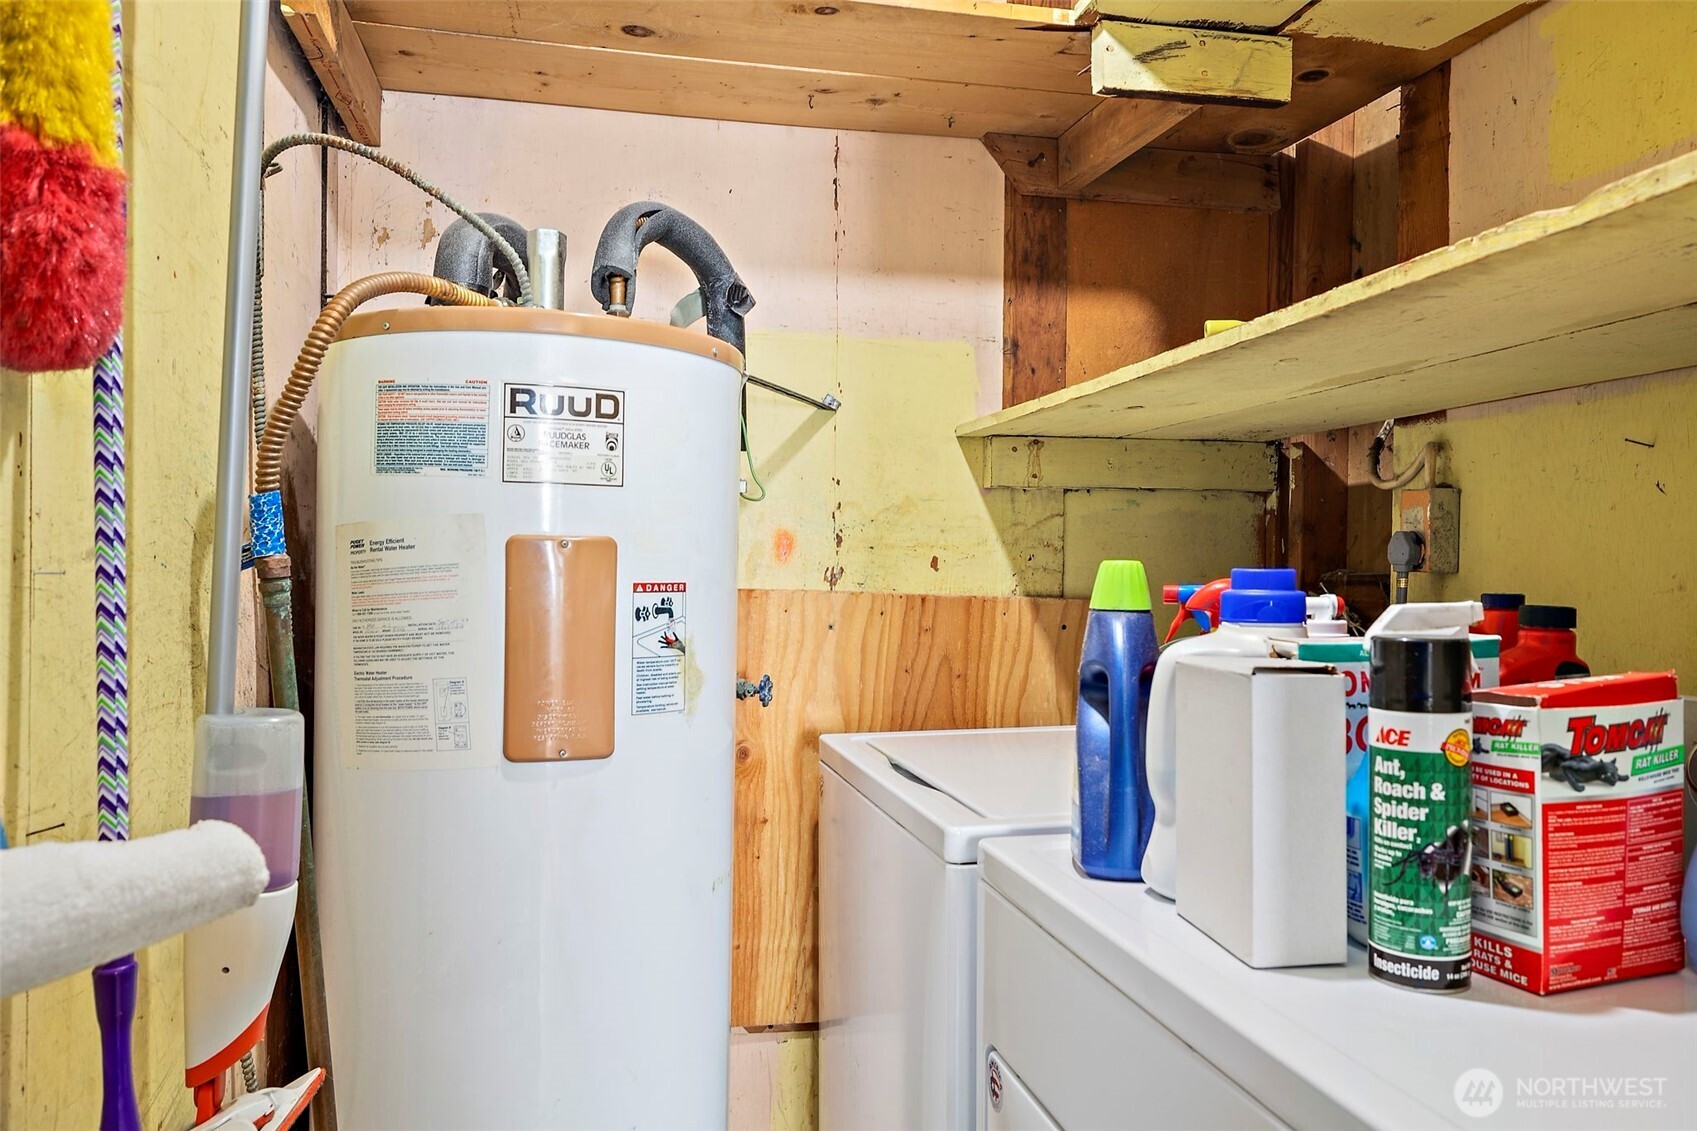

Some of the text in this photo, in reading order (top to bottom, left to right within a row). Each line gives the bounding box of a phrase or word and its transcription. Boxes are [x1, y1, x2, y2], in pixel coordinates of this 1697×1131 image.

[510, 388, 619, 419] RUUD
[1376, 726, 1411, 746] ACE
[1567, 714, 1669, 756] TOMCAT
[1495, 741, 1540, 750] RAT KILLER
[1375, 755, 1405, 780] Ant,
[1635, 750, 1678, 769] RAT KILLER
[1485, 768, 1501, 777] USED
[1374, 776, 1446, 801] Roach &
[1490, 778, 1530, 789] LOCATIONS
[1374, 797, 1429, 821] Spider
[1474, 937, 1512, 958] KILLS
[1374, 953, 1440, 981] Insecticide
[1474, 949, 1512, 969] RATS &
[1500, 969, 1528, 986] MICE
